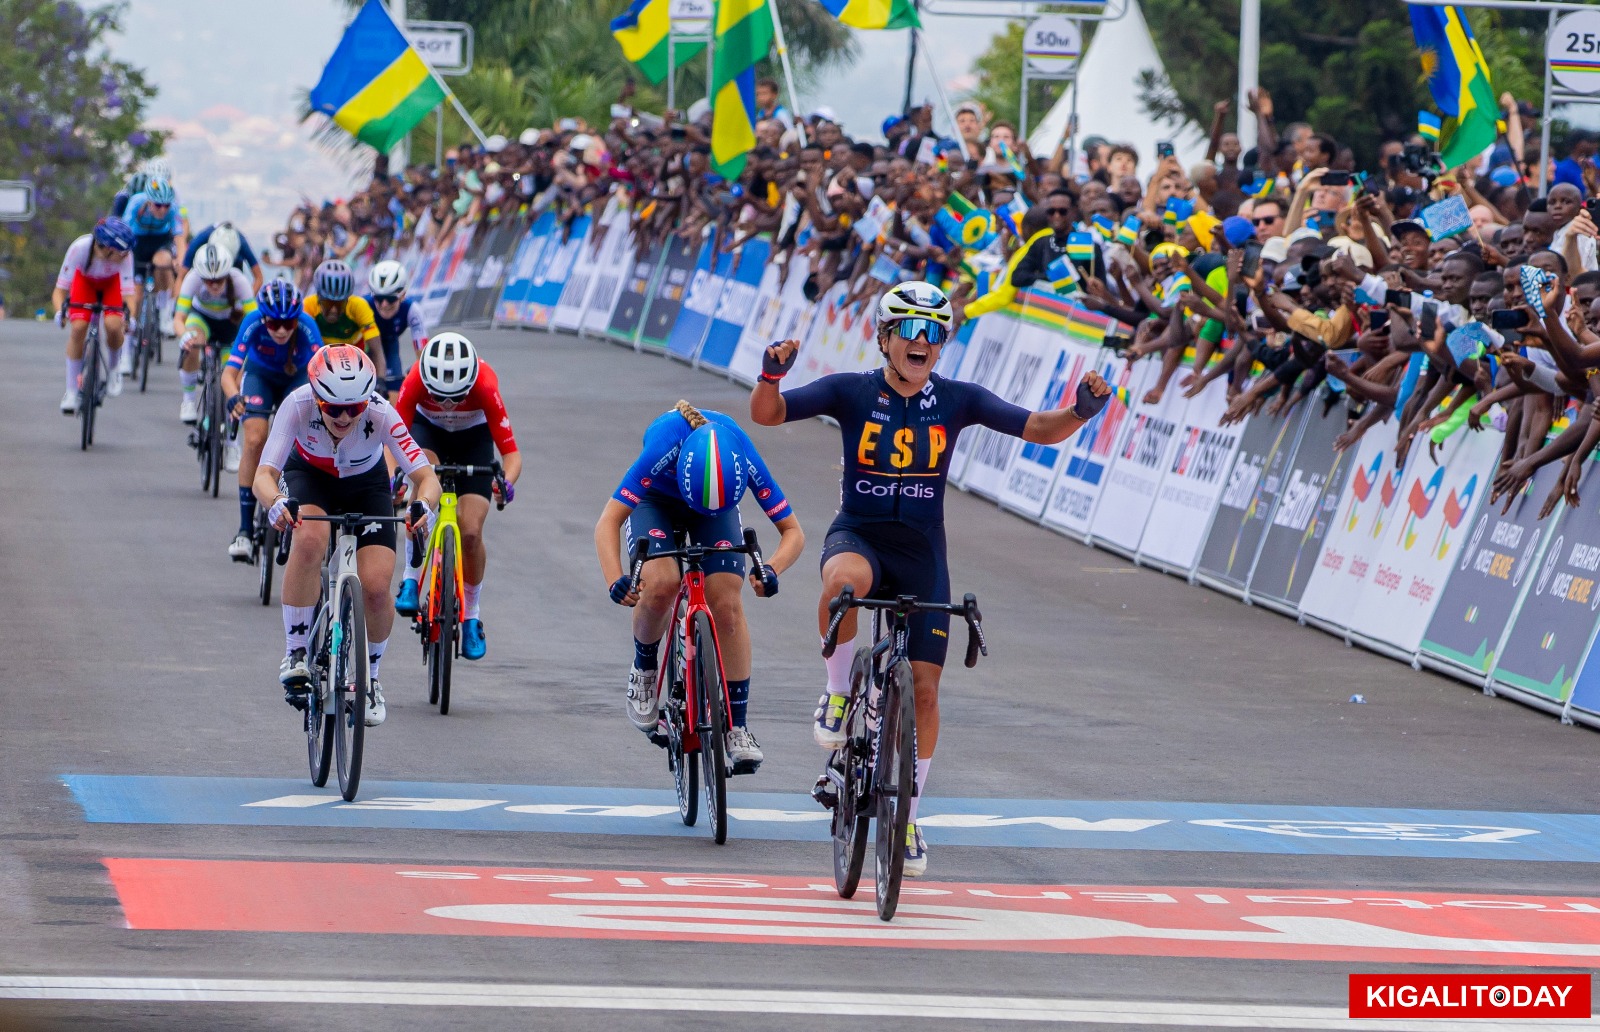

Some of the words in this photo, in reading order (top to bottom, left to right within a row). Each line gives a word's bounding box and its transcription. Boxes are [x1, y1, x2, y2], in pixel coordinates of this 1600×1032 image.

[1566, 32, 1600, 53] 25
[683, 451, 695, 502] RUDY
[855, 479, 935, 498] Cofidis
